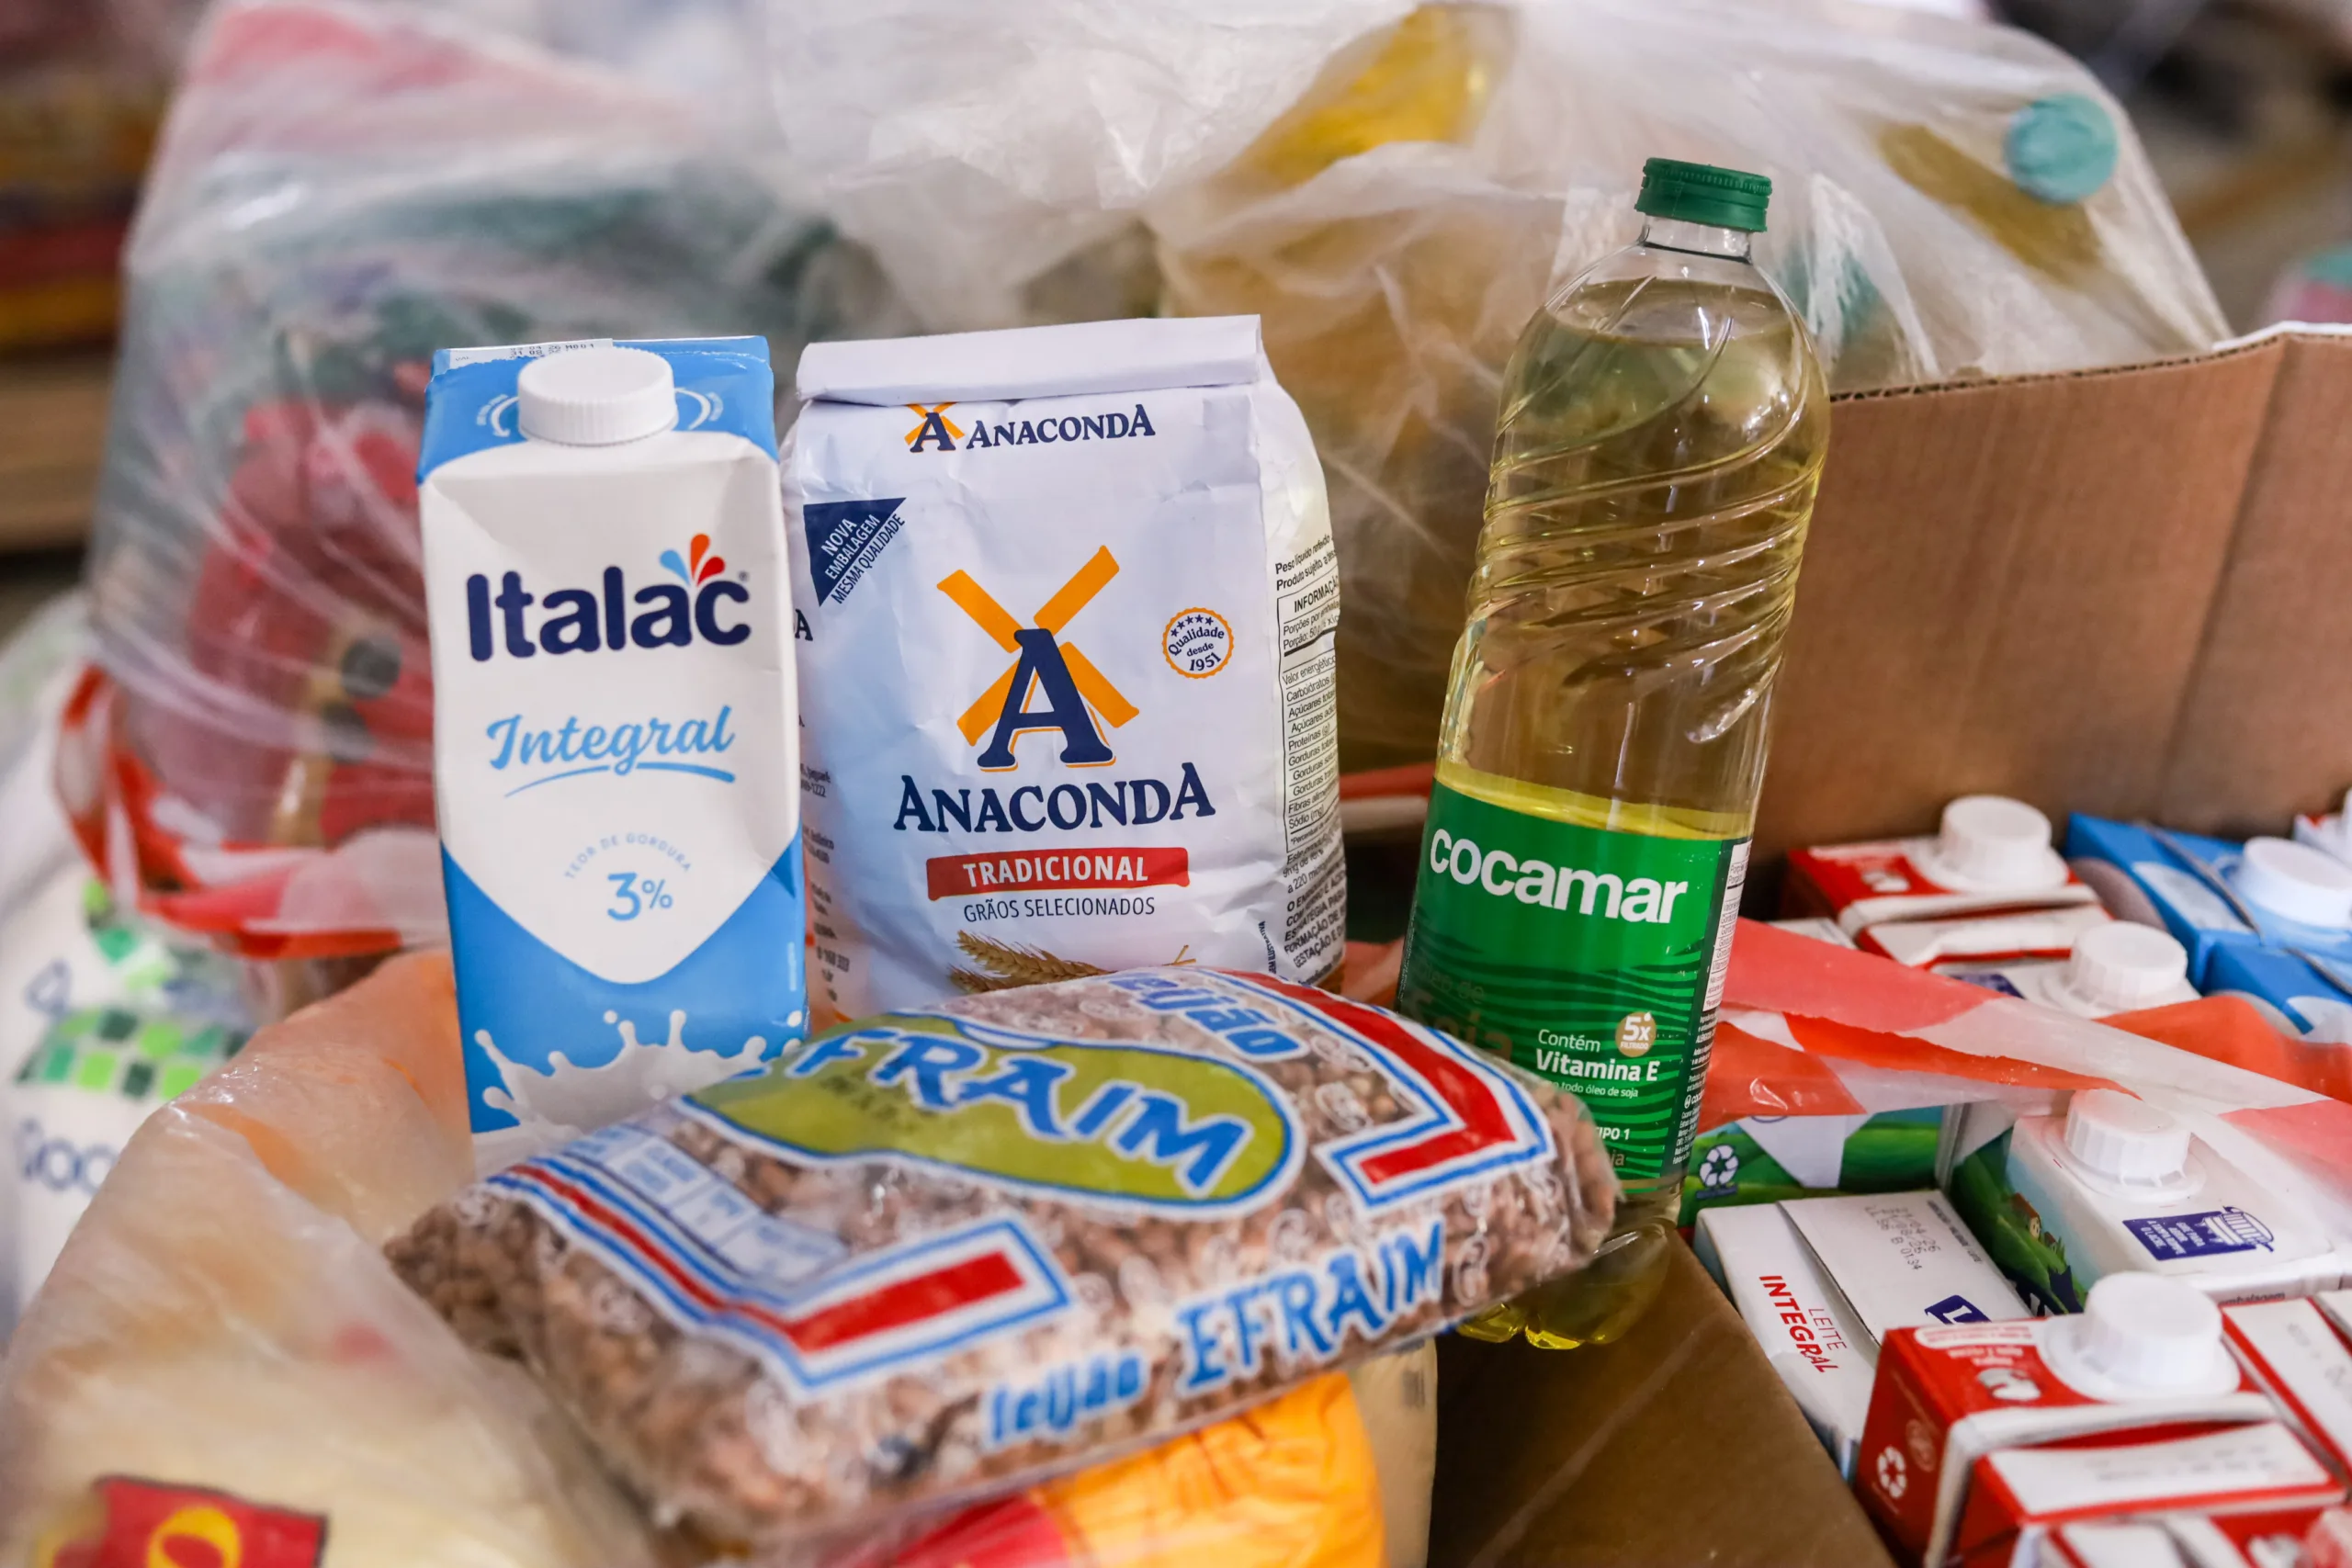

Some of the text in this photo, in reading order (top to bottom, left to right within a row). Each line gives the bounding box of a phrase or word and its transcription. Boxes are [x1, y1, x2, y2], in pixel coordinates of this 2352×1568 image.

[966, 404, 1156, 449] ANACONDA
[820, 518, 857, 557] NOVA
[825, 514, 880, 580] EMBALAGEM
[831, 513, 906, 604] MESMA QUALIDADE
[1275, 559, 1295, 575] Peso
[1276, 571, 1305, 592] Produto
[466, 566, 752, 662] Italac
[1283, 618, 1309, 636] Porções
[1168, 626, 1225, 656] Qualidade
[1186, 642, 1215, 657] desde
[1189, 651, 1222, 671] 1951
[1282, 671, 1299, 685] Valor
[1286, 676, 1330, 702] Carboidratos
[1289, 697, 1322, 718] Açúcares
[1291, 713, 1323, 733] Açúcares
[487, 705, 736, 776] Integral
[1288, 729, 1321, 751] Proteínas
[1288, 746, 1320, 766] Gorduras
[1293, 760, 1324, 780] Gorduras
[893, 761, 1216, 833] ANACONDA
[1293, 775, 1324, 796] Gorduras
[1288, 798, 1311, 814] Fibras
[1288, 813, 1309, 829] Sódio
[562, 831, 692, 879] TEOR DE GORDURA
[963, 855, 1148, 888] TRADICIONAL
[1293, 873, 1307, 890] 220
[1430, 829, 1689, 924] cocamar
[606, 871, 673, 922] 3%
[1286, 900, 1295, 912] O
[964, 897, 1156, 923] GRÃOS SELECIONADOS
[1623, 1014, 1653, 1042] 5x
[1538, 1029, 1601, 1053] Contém
[1620, 1041, 1650, 1051] FILTRADO
[1536, 1048, 1661, 1082] Vitamina E
[1585, 1081, 1606, 1096] óleo
[1608, 1085, 1620, 1097] de
[1621, 1086, 1639, 1100] soja
[1623, 1128, 1631, 1140] 1
[1177, 1220, 1445, 1390] EFRAIM
[1758, 1275, 1839, 1373] INTEGRAL
[1808, 1308, 1848, 1351] LEITE
